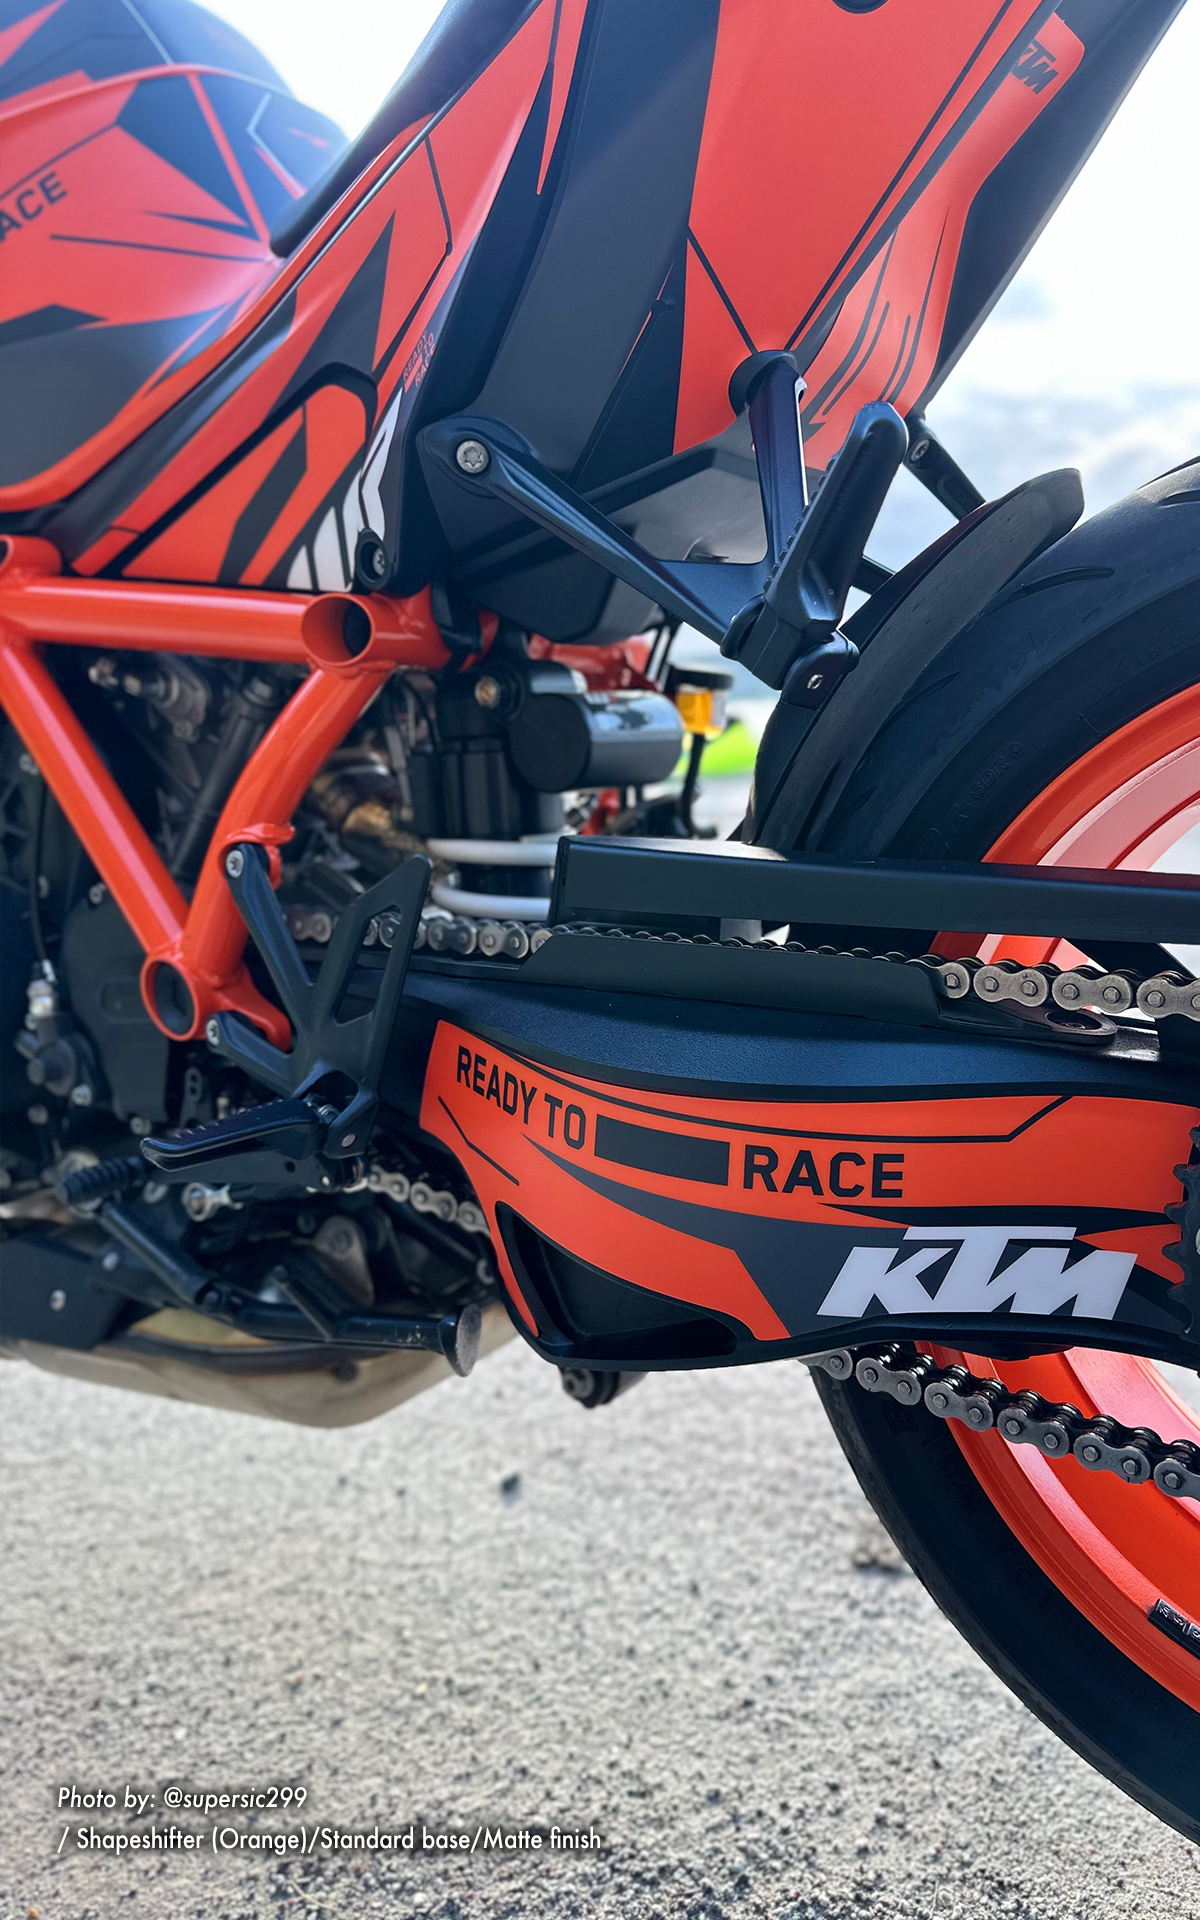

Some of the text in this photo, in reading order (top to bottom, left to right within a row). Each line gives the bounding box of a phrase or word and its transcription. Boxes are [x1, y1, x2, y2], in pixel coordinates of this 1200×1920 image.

[456, 1044, 905, 1199] READY TO RACE
[816, 1225, 1138, 1320] KTM
